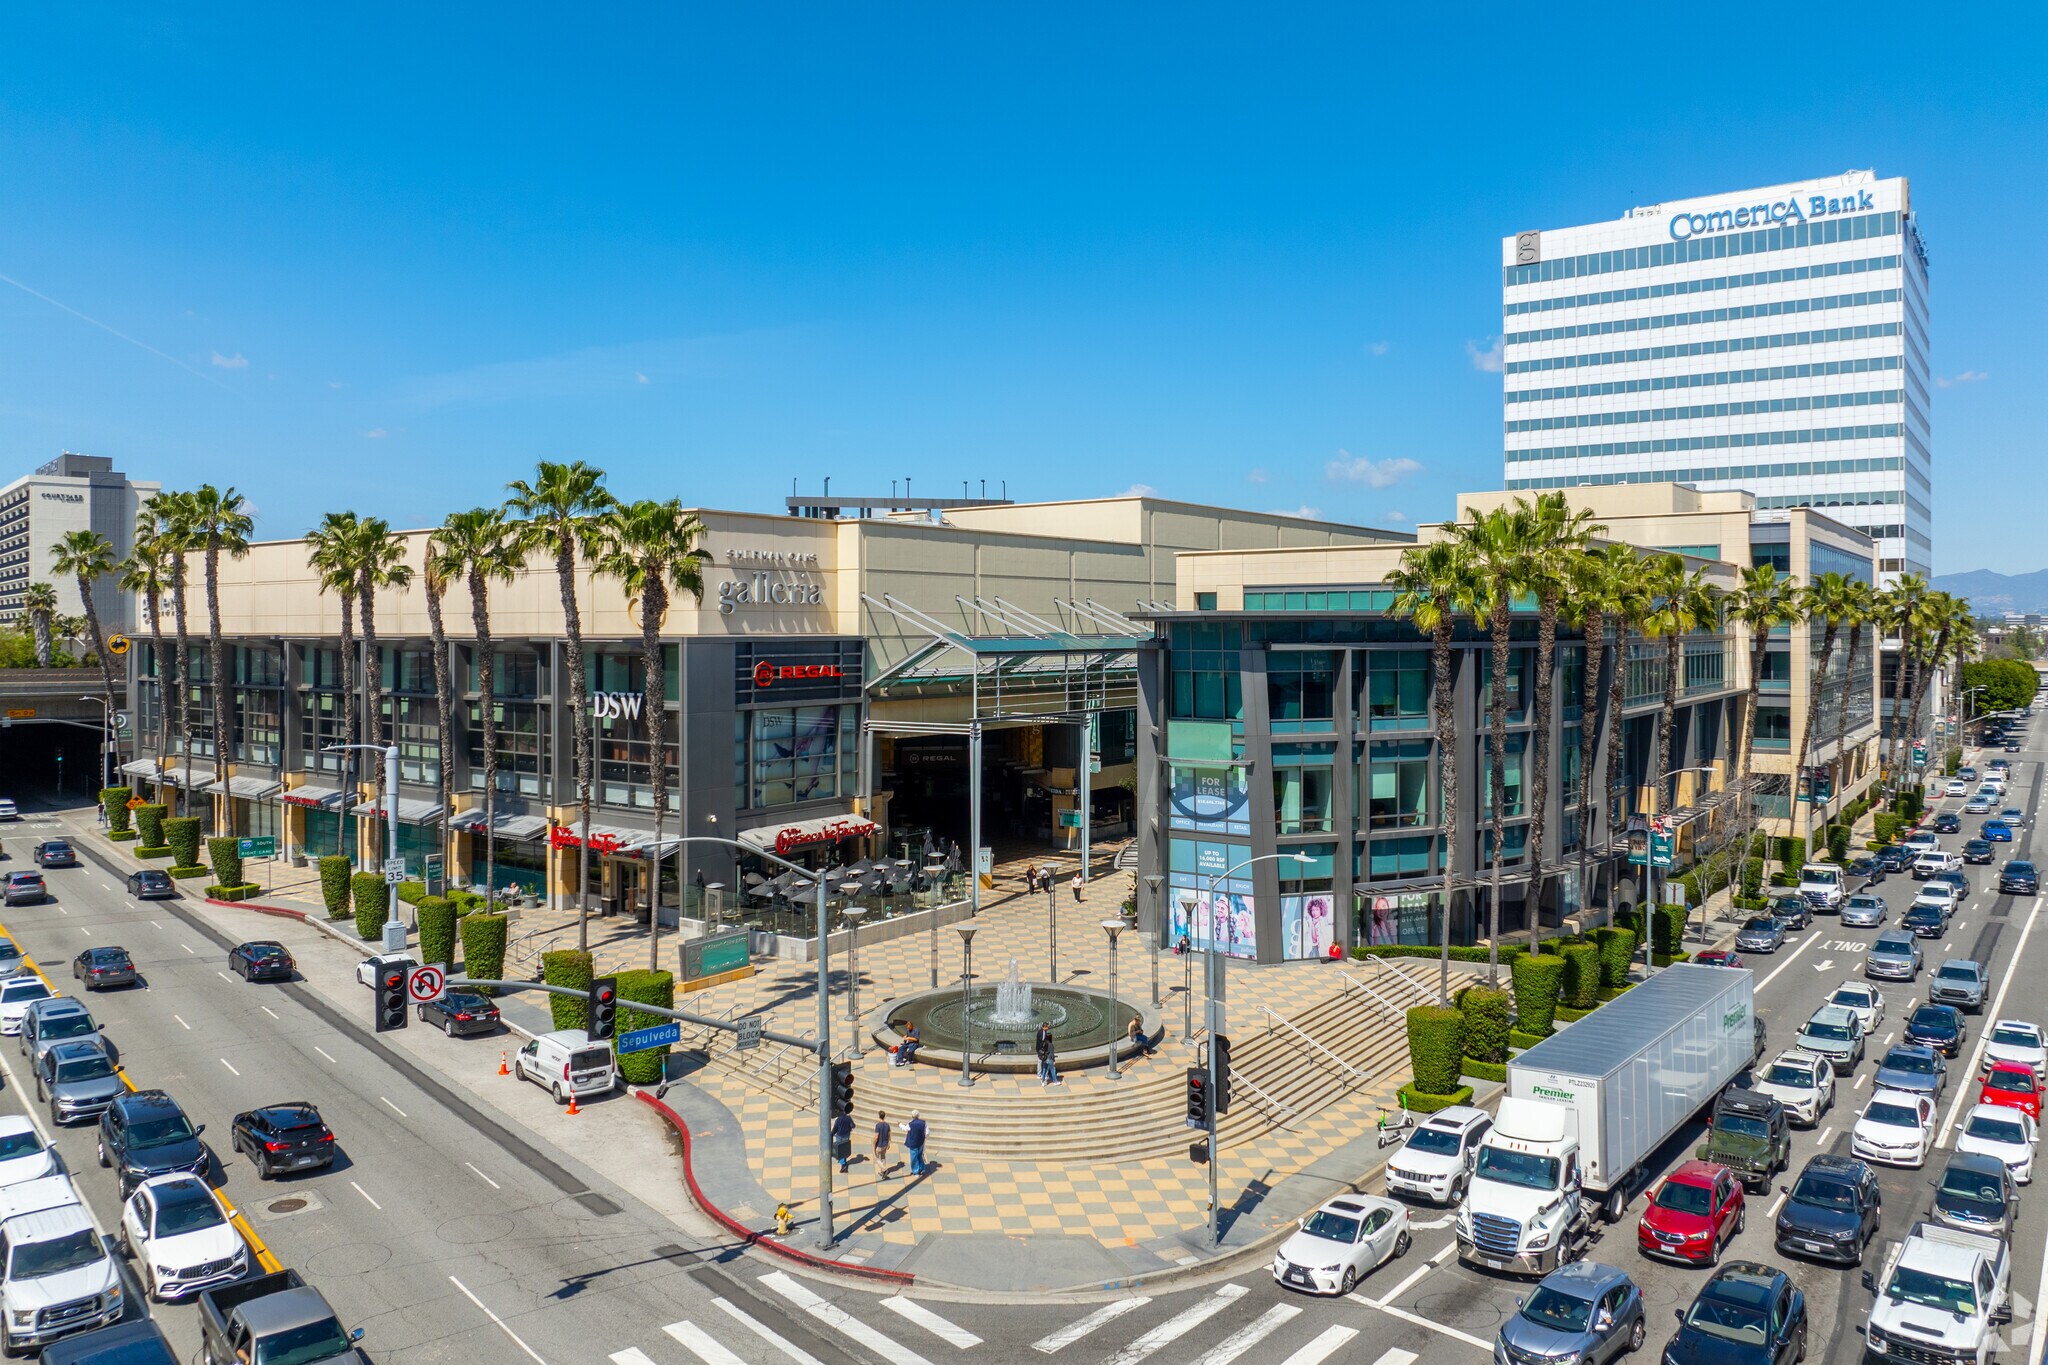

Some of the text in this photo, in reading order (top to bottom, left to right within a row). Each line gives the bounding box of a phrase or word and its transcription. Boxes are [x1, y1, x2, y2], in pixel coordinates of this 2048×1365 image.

[1808, 189, 1874, 218] Bank
[726, 549, 817, 562] SHERMAN OAKS
[718, 570, 824, 616] galleria
[779, 664, 844, 679] REGAL
[593, 690, 643, 720] DSW
[762, 716, 783, 728] DSW
[1201, 777, 1220, 787] FOR
[1197, 787, 1225, 796] LEASE
[832, 821, 876, 845] Factory
[1199, 861, 1226, 869] AVAILABLE
[387, 871, 404, 882] 35
[1818, 940, 1867, 952] ONLY
[738, 1019, 760, 1031] DO NOT
[620, 1028, 678, 1048] Sepulveda
[738, 1030, 760, 1041] BLOCK
[1533, 1085, 1576, 1100] Premier
